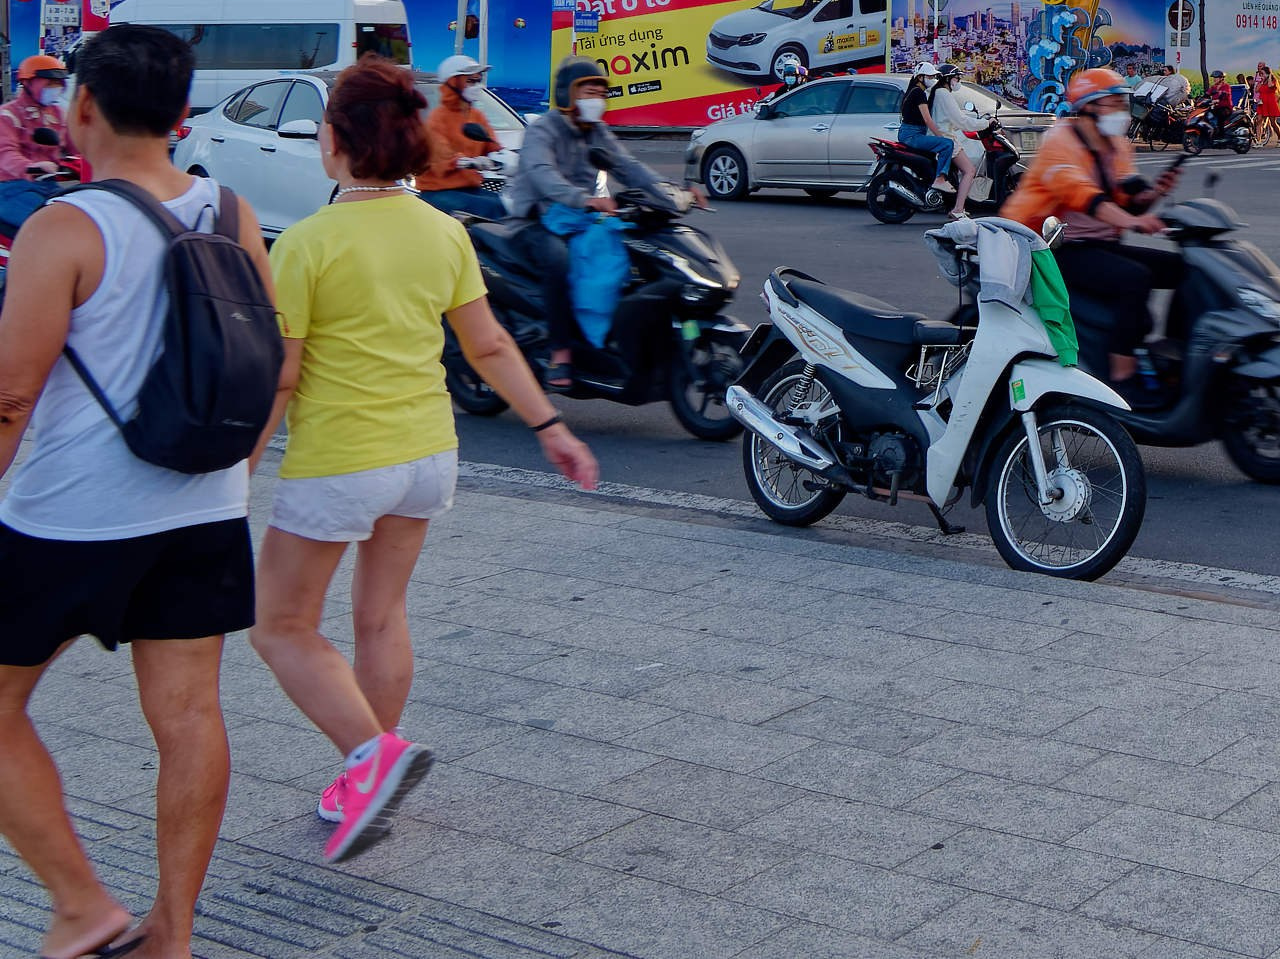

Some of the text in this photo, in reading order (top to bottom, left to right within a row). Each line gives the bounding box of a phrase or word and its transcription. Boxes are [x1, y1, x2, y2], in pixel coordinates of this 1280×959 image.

[1236, 14, 1259, 29] 0914
[1261, 15, 1277, 30] 148
[577, 27, 664, 51] Tải ứng dụng
[707, 100, 739, 121] Giá
